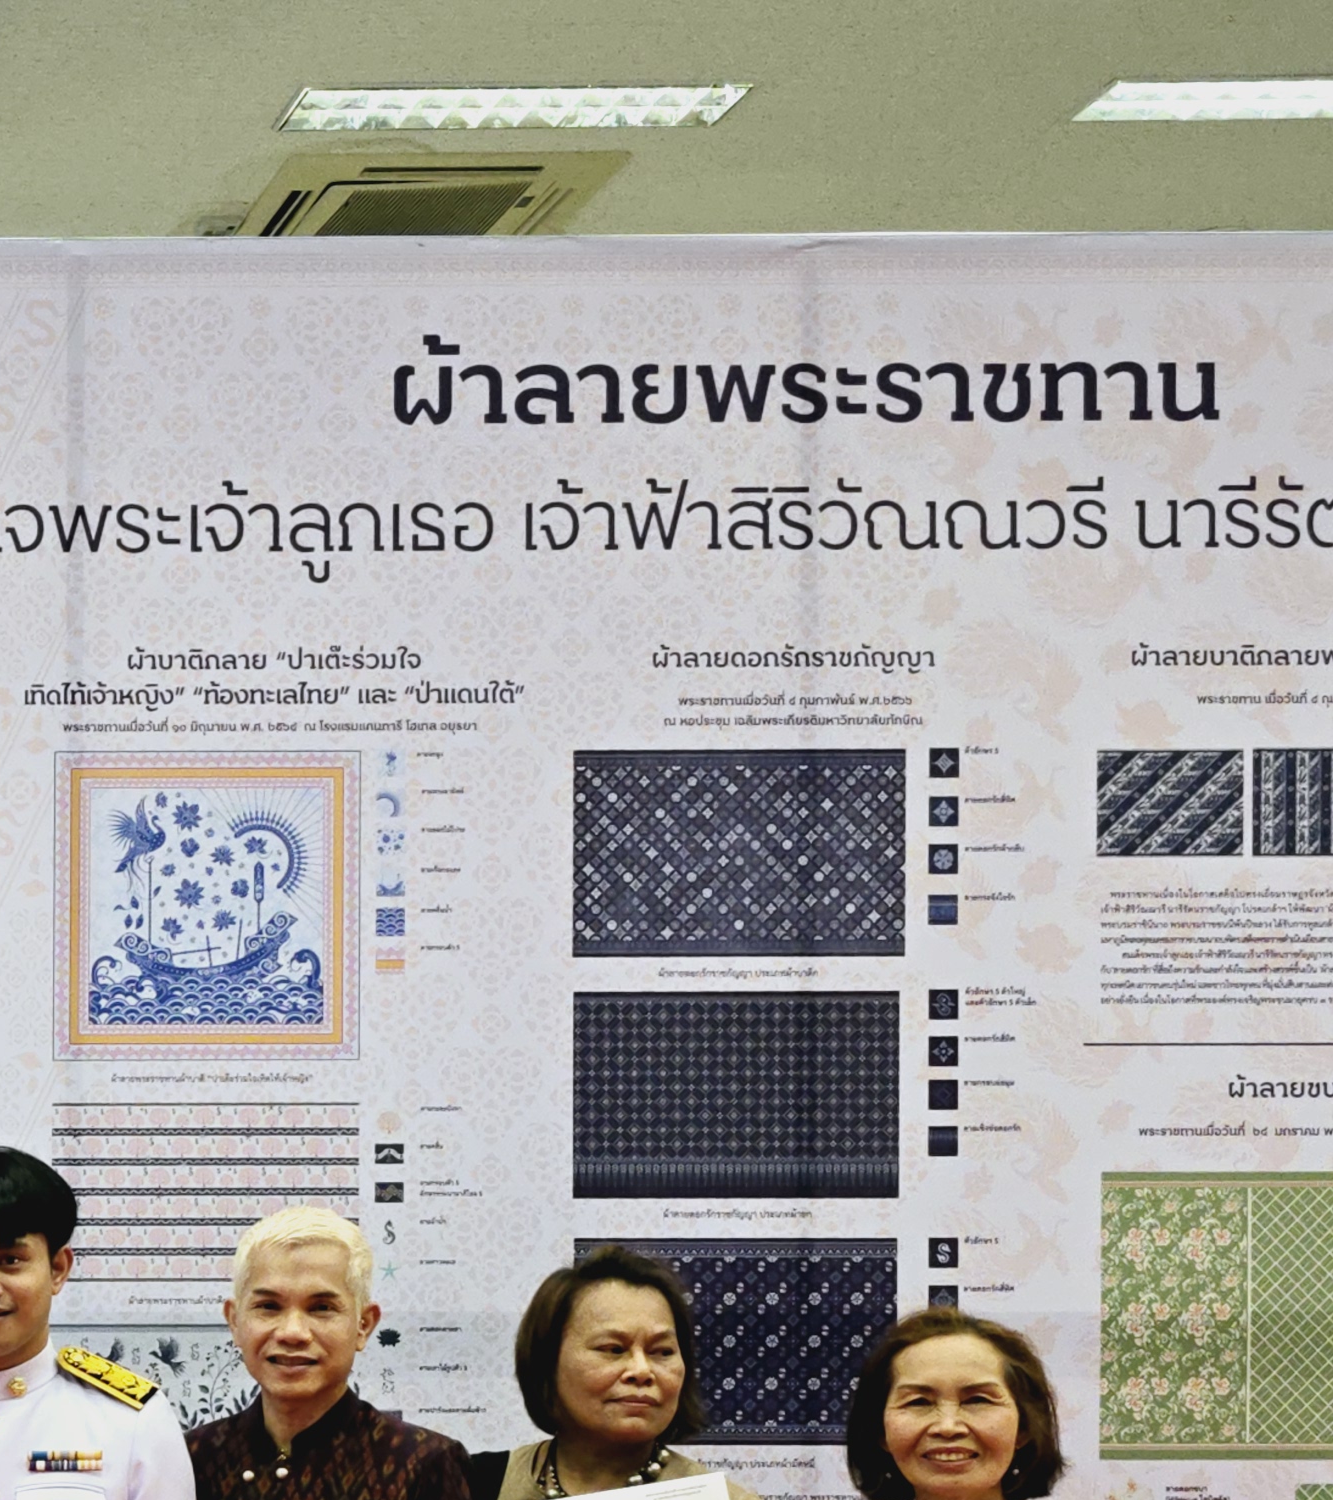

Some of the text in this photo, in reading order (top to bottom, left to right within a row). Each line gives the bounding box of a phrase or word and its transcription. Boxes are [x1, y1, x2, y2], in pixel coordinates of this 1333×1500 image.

[394, 335, 1219, 425] ผ้าลายพระราชทาน
[526, 476, 1107, 550] เจ้าฟ้าสิริวัณณวรี
[127, 645, 422, 671] ผ้าบาติกลาย “ปาเต๊ะร่วมใจ
[652, 643, 936, 675] ผ้าลายดอกรักราชกัญญา
[24, 679, 525, 713] เทิดไท้เจ้าหญิง” “ท้องทะเลไทย” และ “ป่าแดนใต้”
